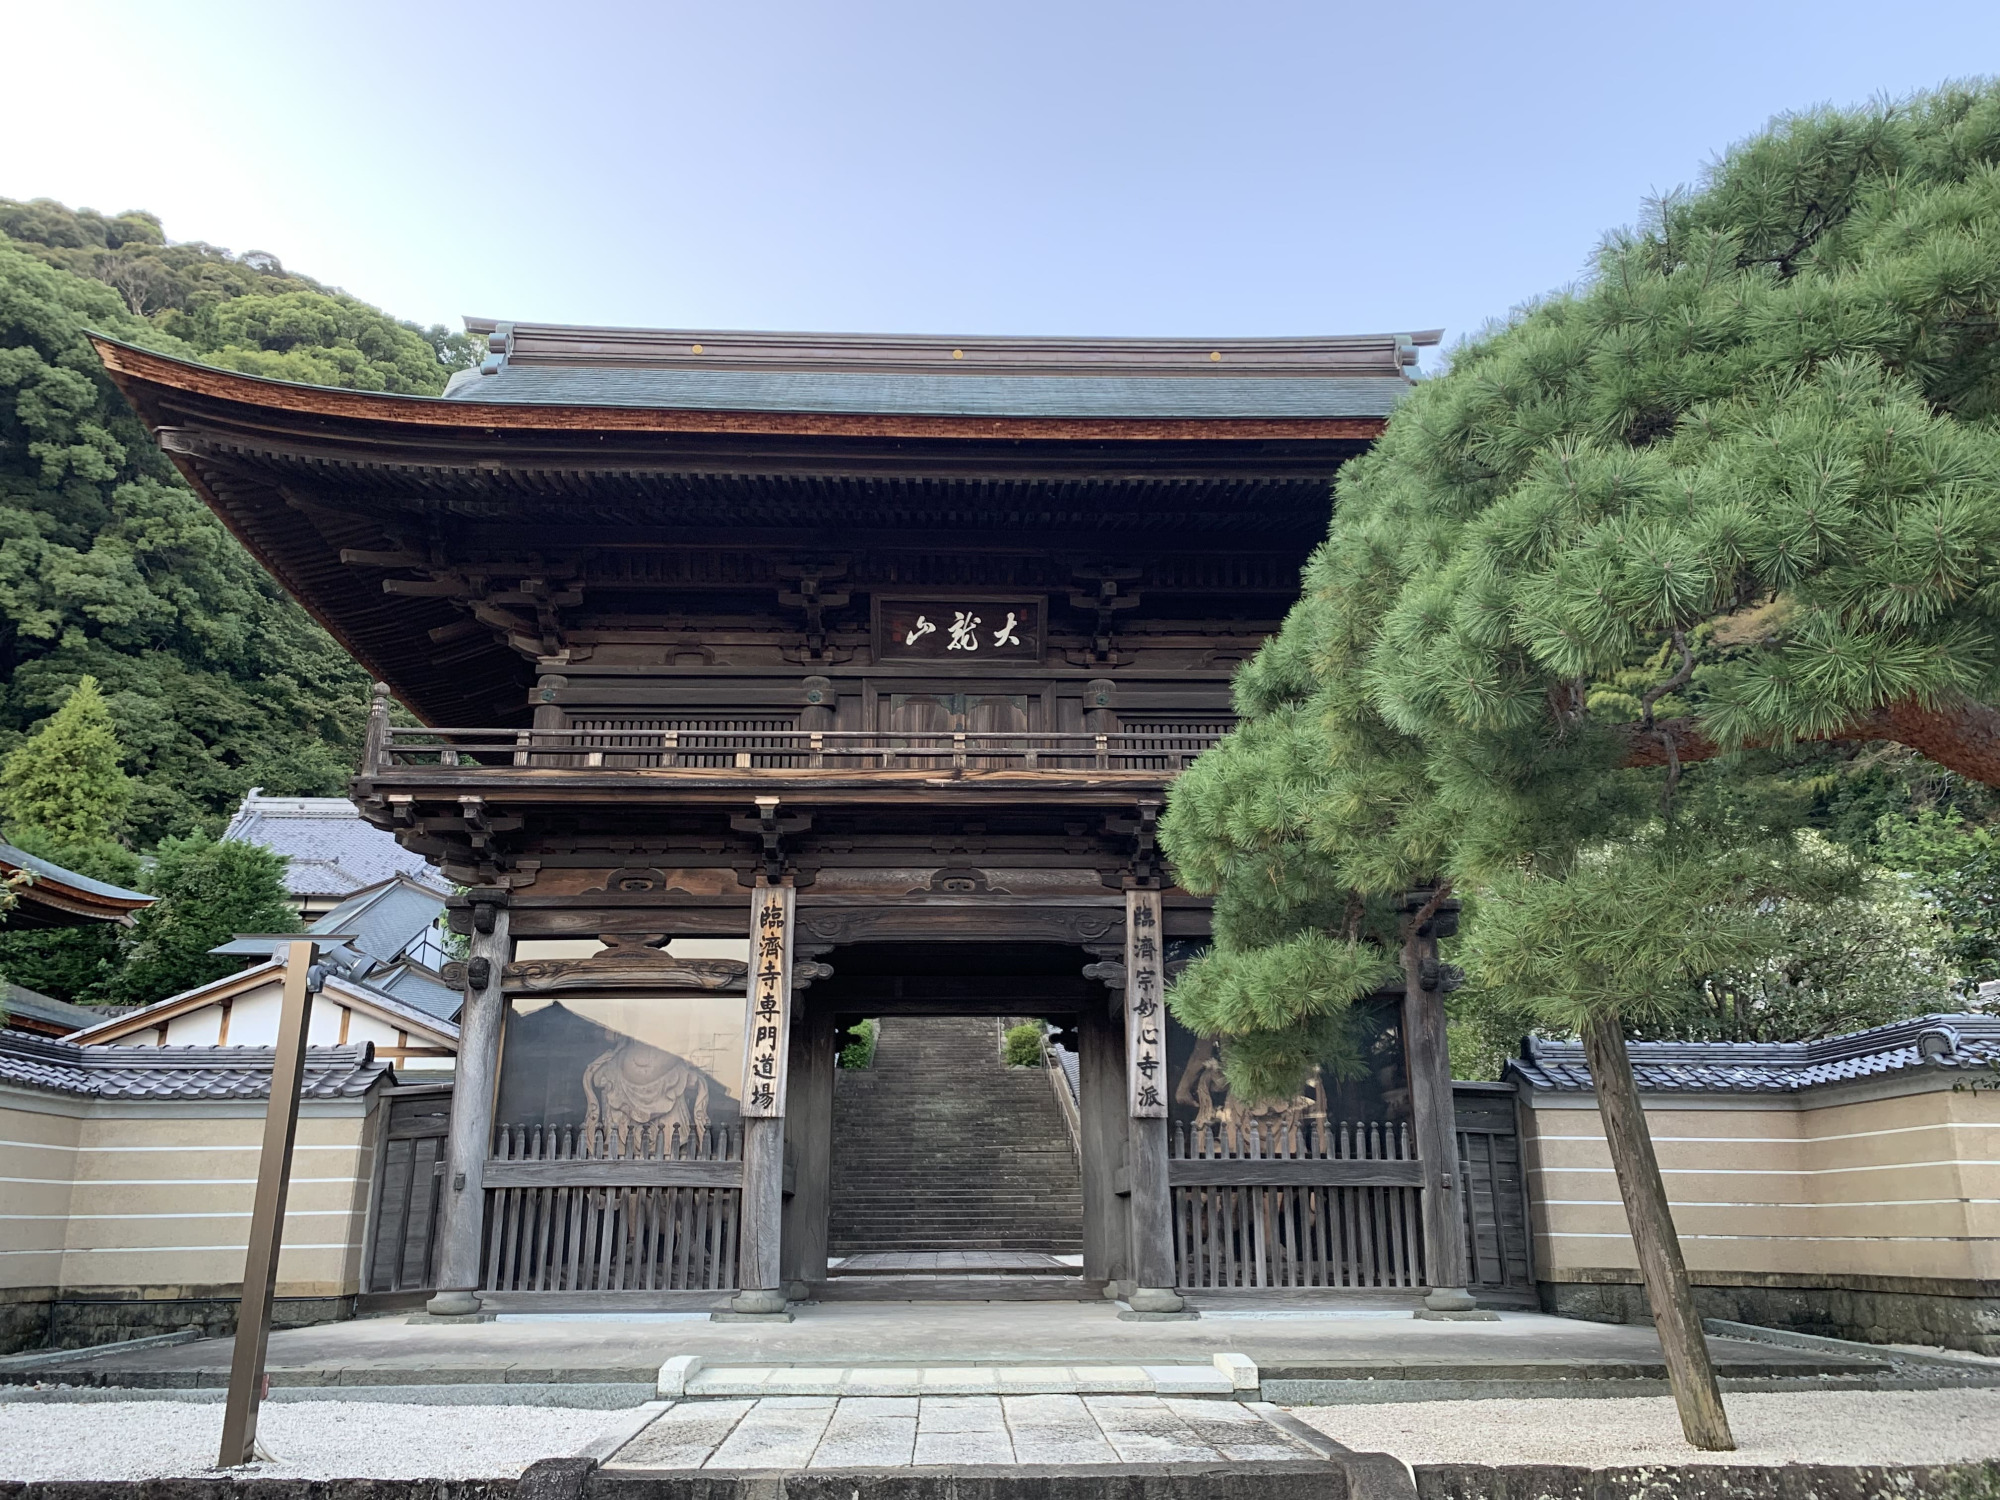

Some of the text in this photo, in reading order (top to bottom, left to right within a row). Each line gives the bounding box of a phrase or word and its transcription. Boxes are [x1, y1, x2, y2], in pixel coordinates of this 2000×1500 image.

[1132, 897, 1166, 1108] 臨濟宗妙心寺派
